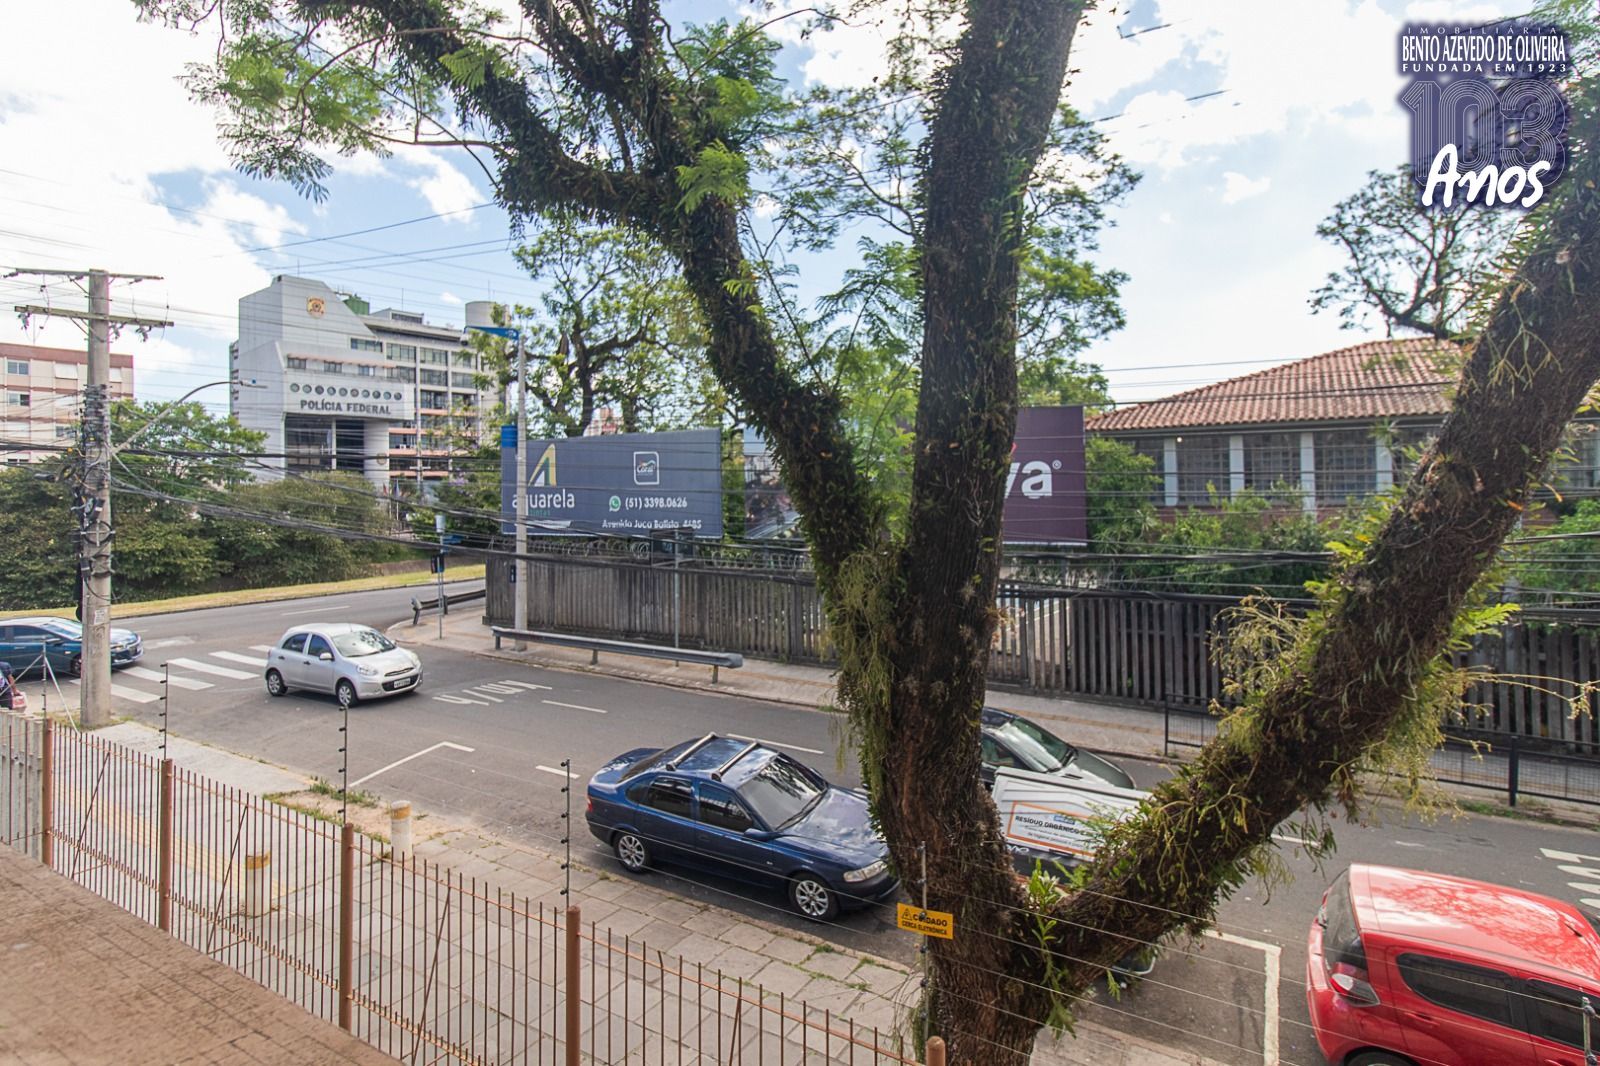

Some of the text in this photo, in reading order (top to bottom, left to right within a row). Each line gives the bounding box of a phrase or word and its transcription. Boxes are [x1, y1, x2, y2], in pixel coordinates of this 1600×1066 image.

[300, 399, 391, 415] POLÍCIA FEDERAL
[511, 488, 575, 516] auarela
[625, 496, 688, 510] (51) 3398.0626
[1015, 815, 1043, 827] RESÍDUO
[912, 913, 948, 927] CDADO
